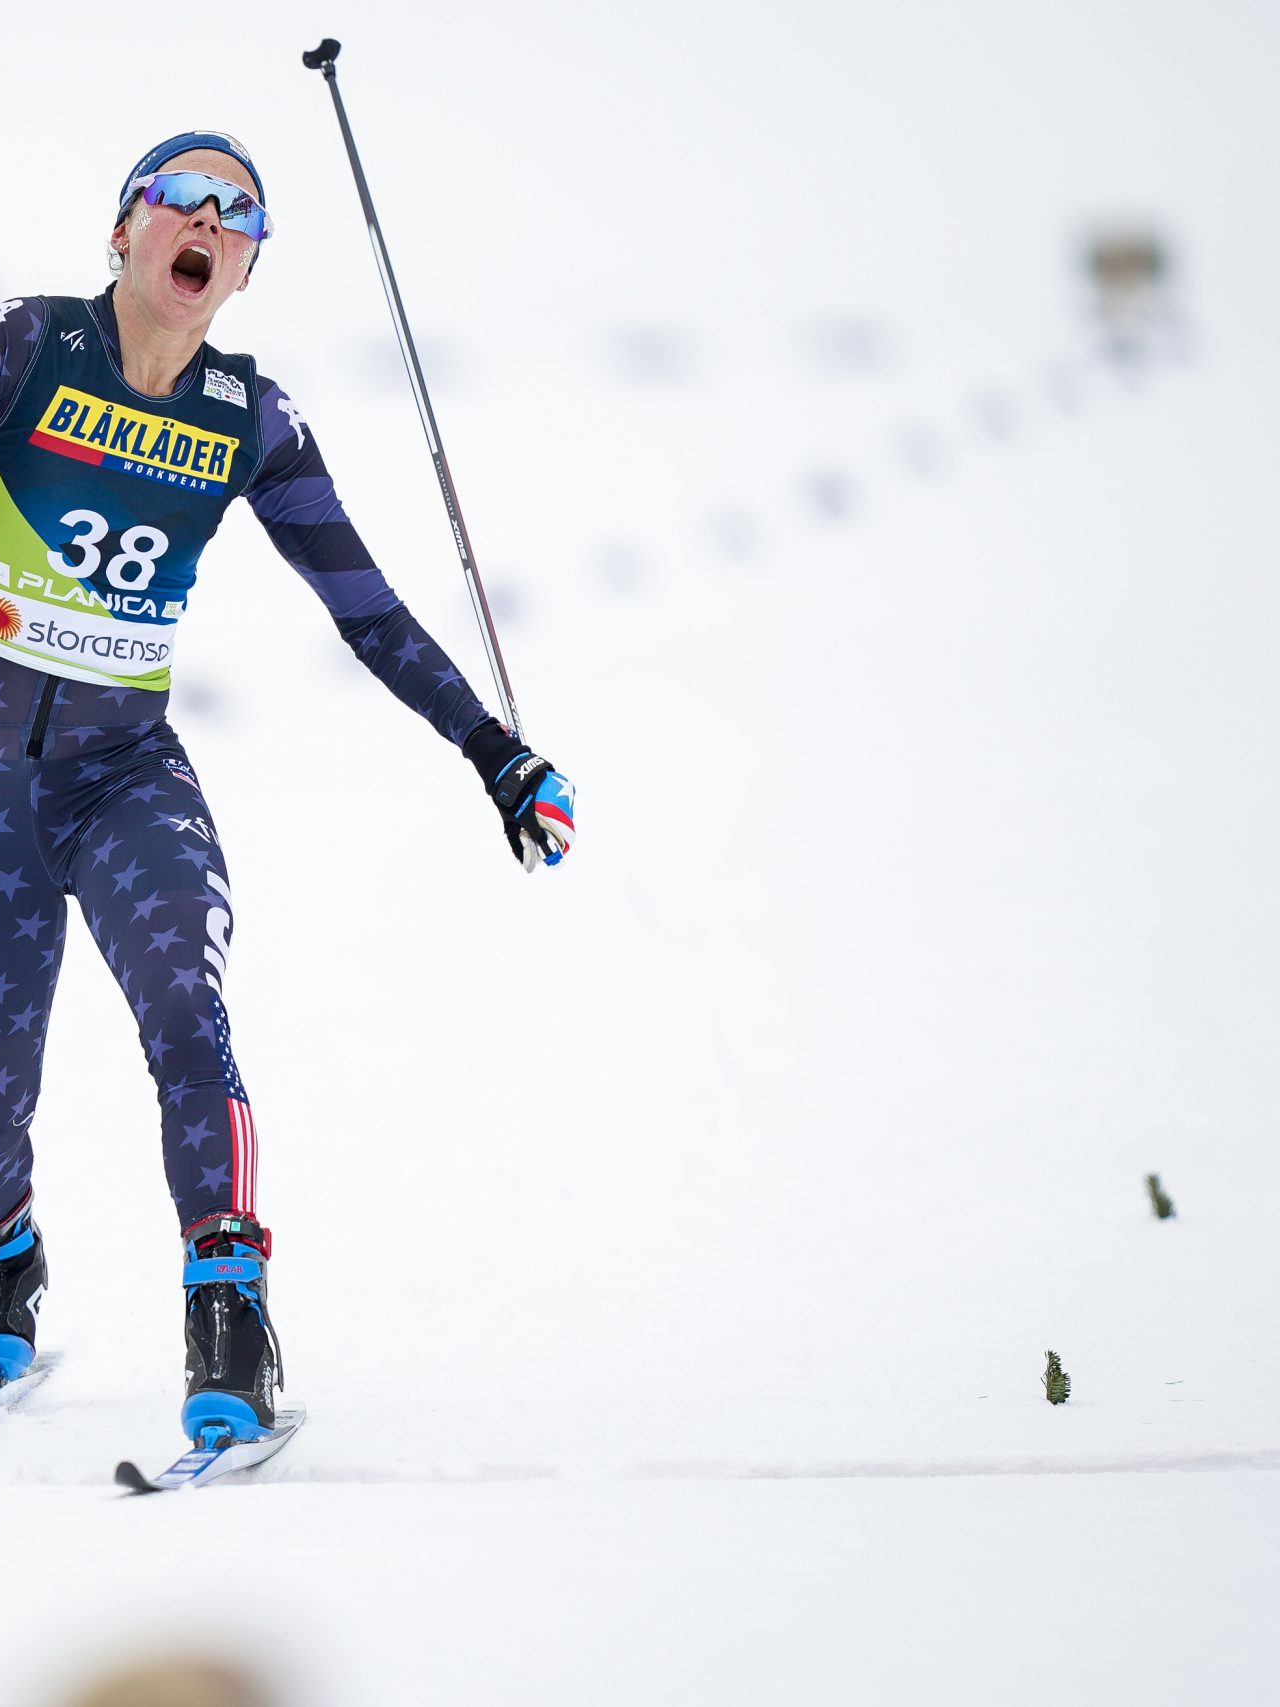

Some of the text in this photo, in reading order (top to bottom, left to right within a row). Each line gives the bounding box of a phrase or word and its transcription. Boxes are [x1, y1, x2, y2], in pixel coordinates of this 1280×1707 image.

[47, 398, 229, 477] BLÅKLÄDER
[123, 461, 207, 490] WORKWEAR
[46, 509, 170, 592] 38
[17, 570, 157, 618] PLANICA
